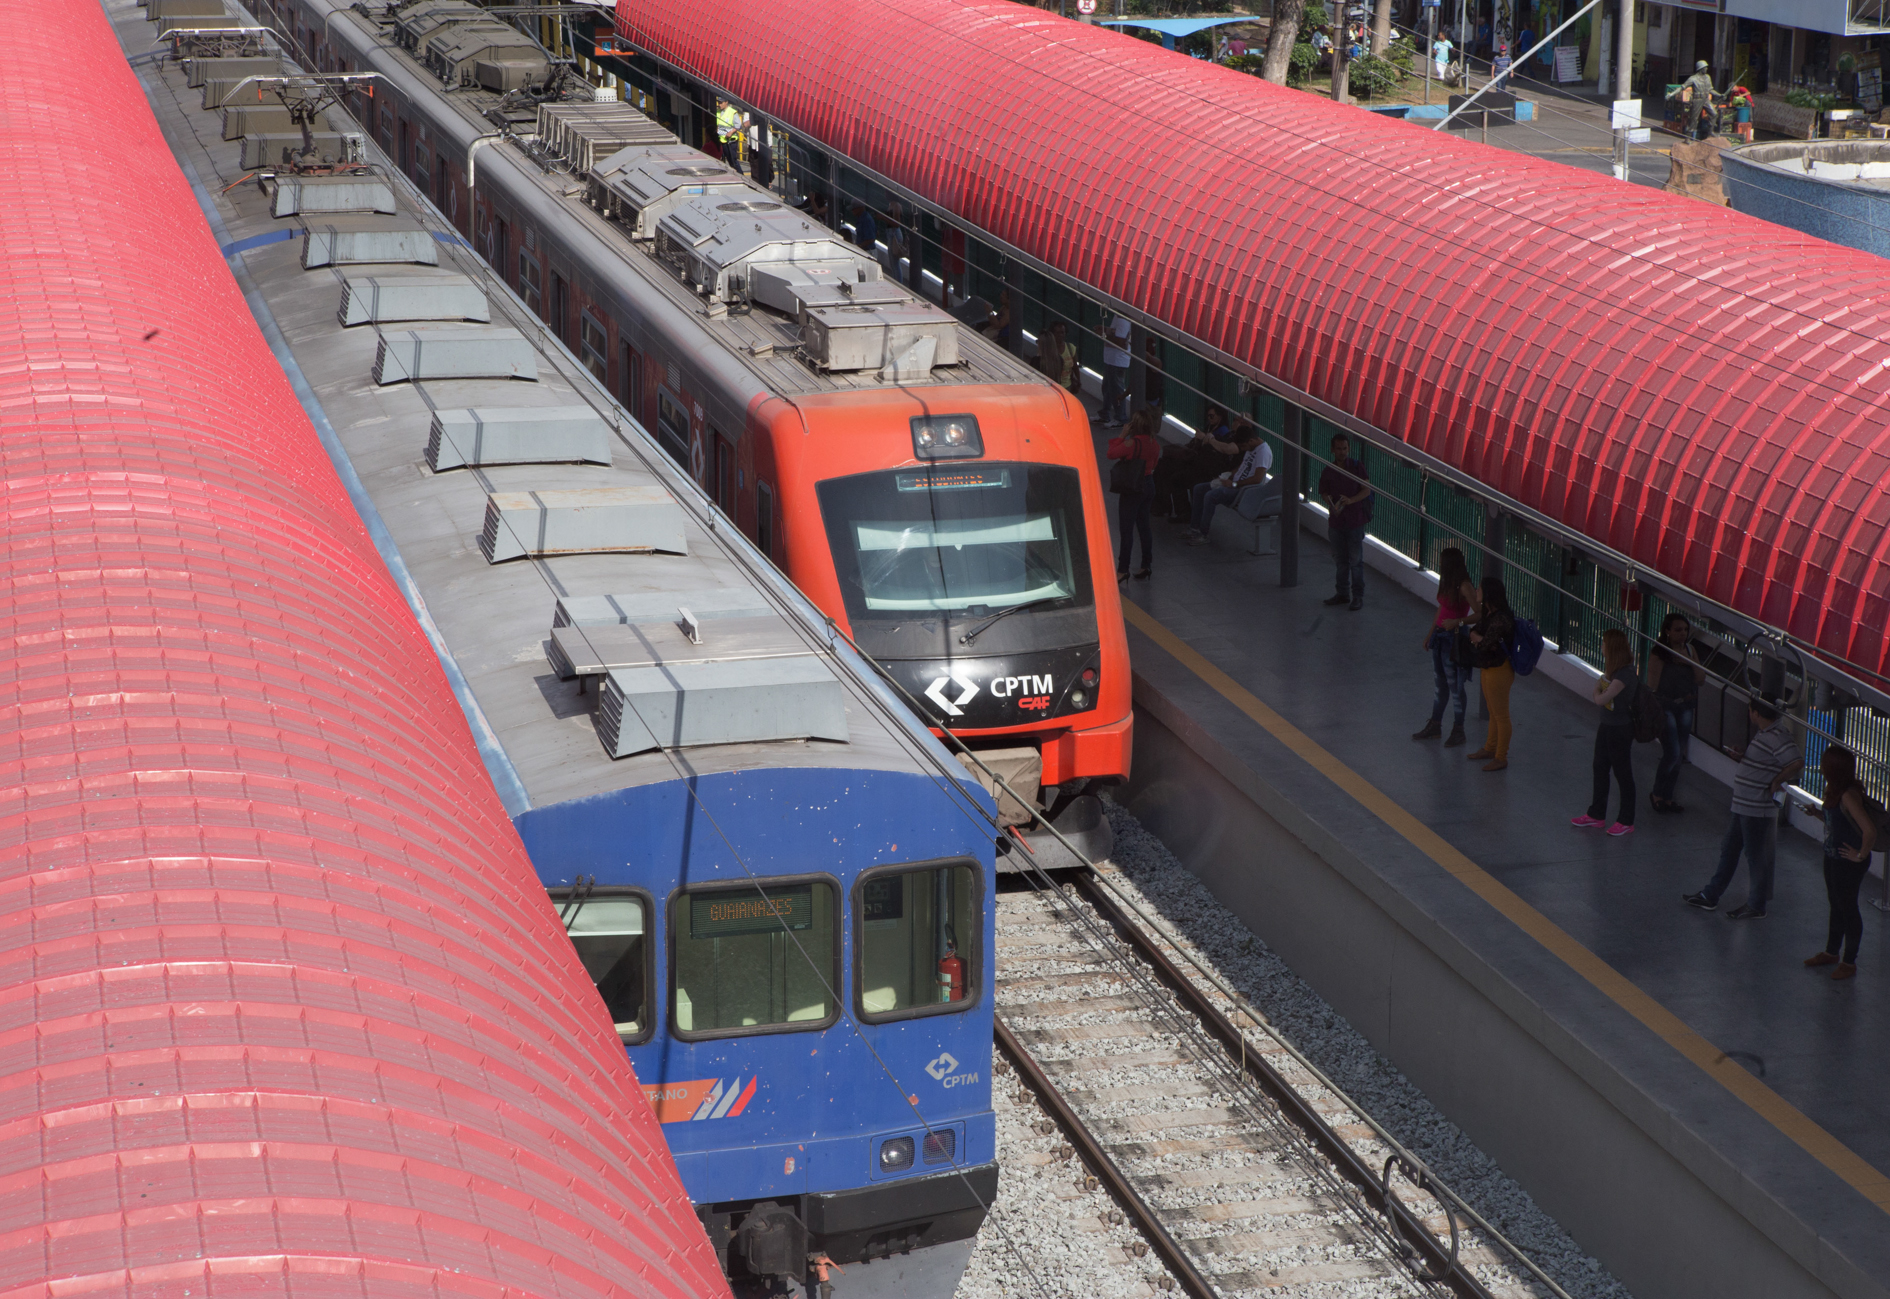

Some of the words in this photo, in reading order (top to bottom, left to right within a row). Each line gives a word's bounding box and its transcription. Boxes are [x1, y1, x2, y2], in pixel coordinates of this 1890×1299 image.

[990, 674, 1054, 698] CPTM
[1018, 695, 1050, 711] CAF
[710, 898, 792, 921] GUAIANAZES
[943, 1072, 979, 1089] CPTM
